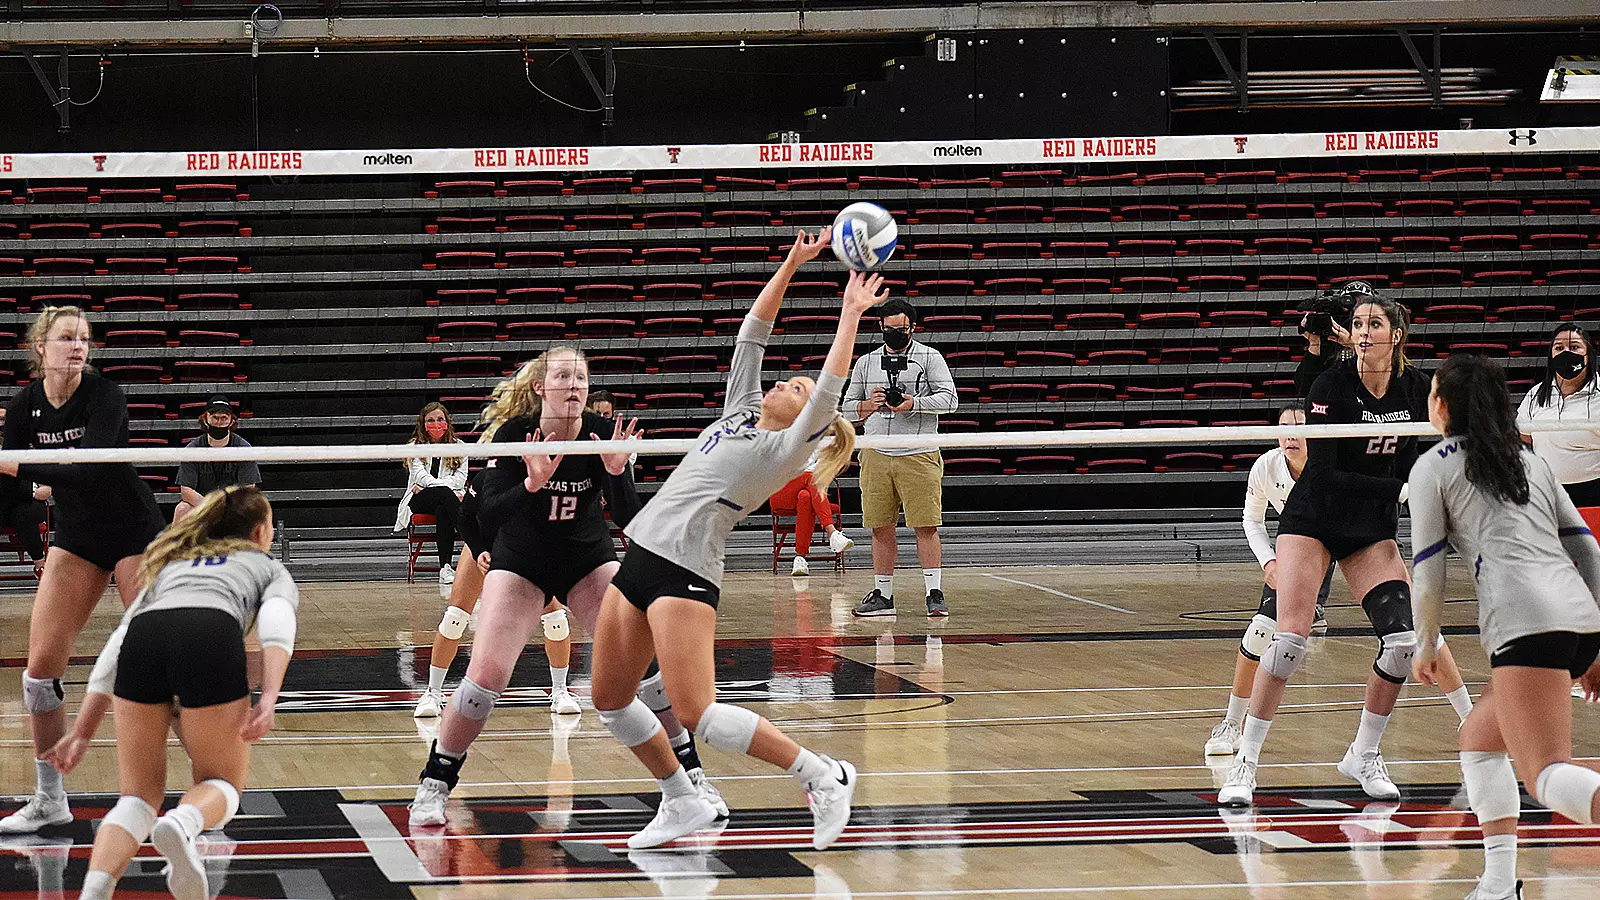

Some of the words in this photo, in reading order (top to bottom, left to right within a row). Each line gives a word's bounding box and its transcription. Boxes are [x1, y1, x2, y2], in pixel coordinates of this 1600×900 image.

[1043, 140, 1076, 157] RED
[1083, 138, 1156, 157] RAIDERS
[1325, 133, 1358, 151] RED
[1365, 131, 1439, 150] RAIDERS
[363, 153, 413, 166] molten
[475, 150, 507, 167] RED
[515, 148, 589, 167] RAIDERS
[759, 145, 792, 162] RED
[800, 143, 873, 161] RAIDERS
[933, 144, 982, 157] molten
[187, 153, 219, 170] RED
[228, 152, 302, 170] RAIDERS
[37, 432, 64, 444] TEXAS
[570, 477, 593, 493] TECH
[548, 495, 578, 521] 12
